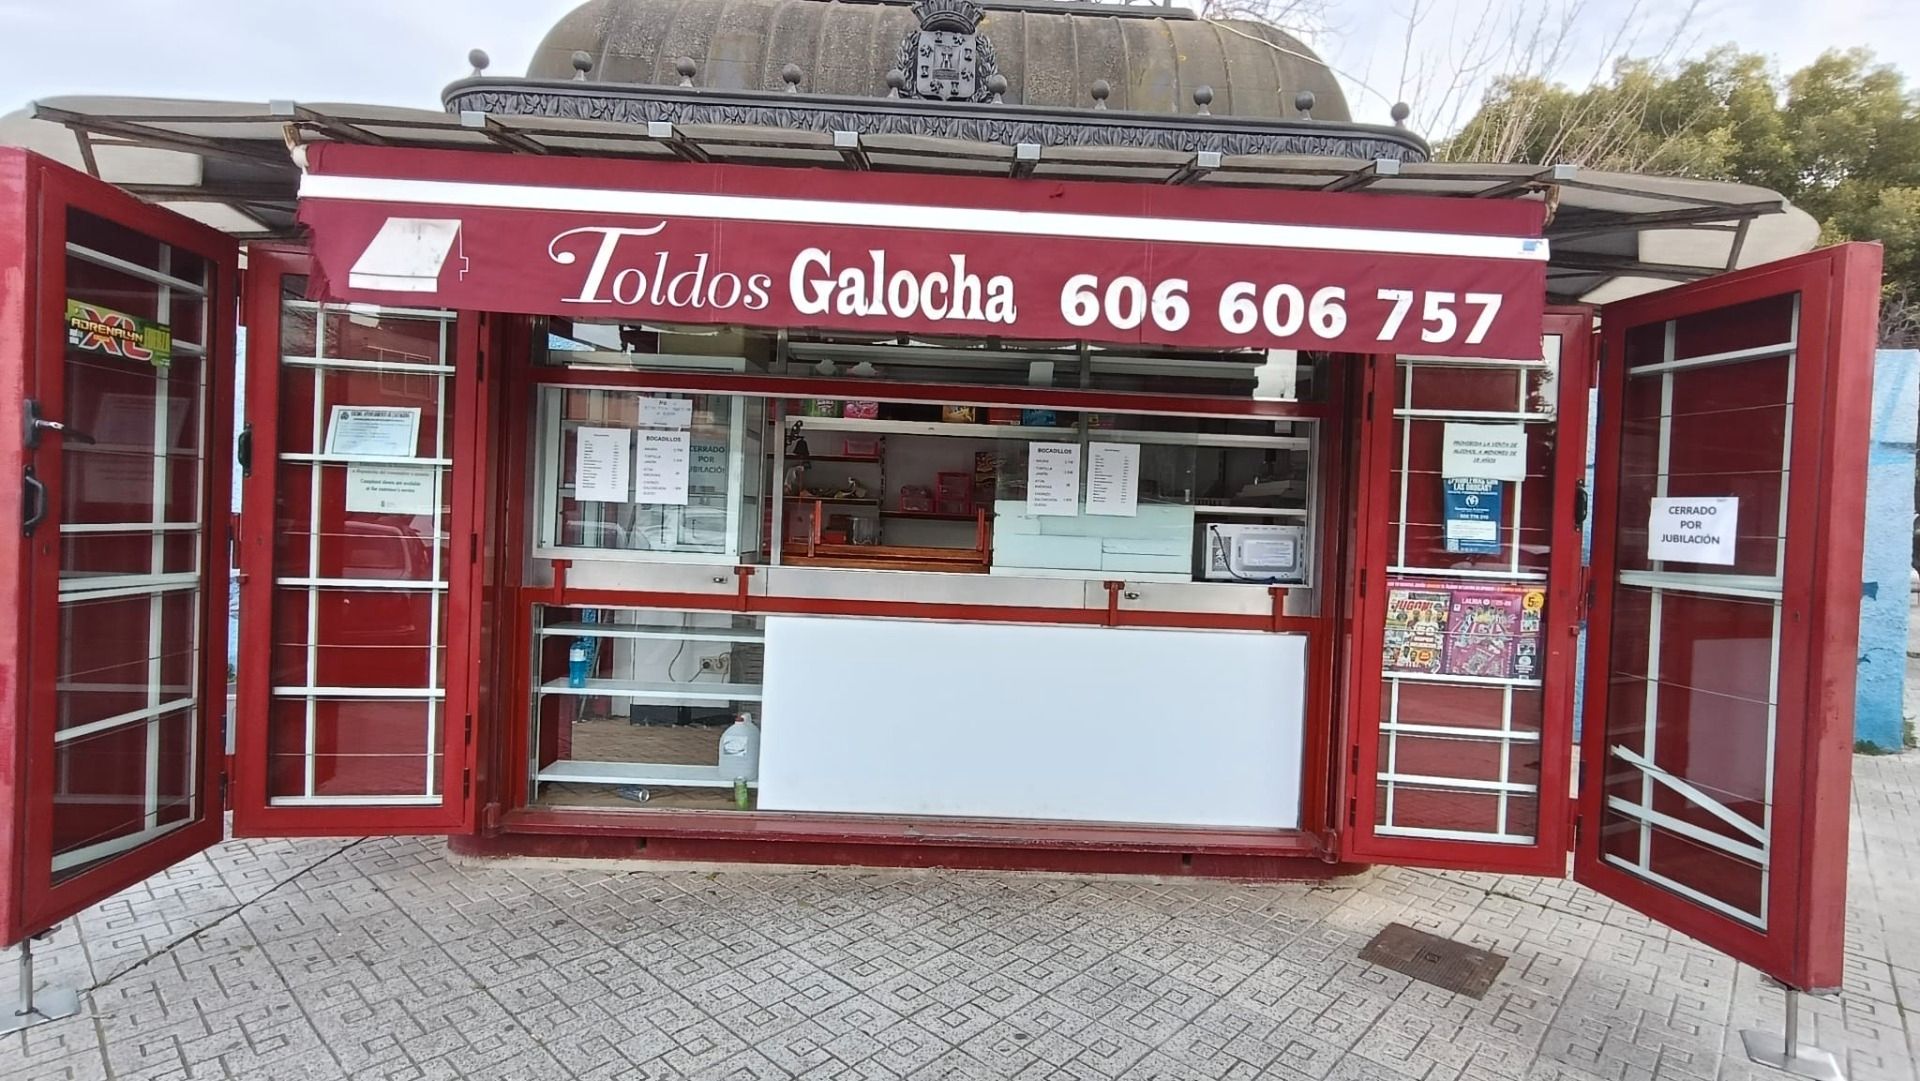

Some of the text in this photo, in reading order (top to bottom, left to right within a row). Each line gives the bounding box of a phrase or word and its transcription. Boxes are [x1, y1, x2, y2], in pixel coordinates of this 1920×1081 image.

[548, 221, 1504, 345] Toldos Galocha 606 606 757
[71, 317, 144, 343] ADRENALYN
[78, 306, 153, 361] XL
[646, 435, 682, 443] BOCADILLOS
[1038, 447, 1072, 455] BOCADILLOS
[1668, 506, 1717, 515] CERRADO
[1680, 520, 1702, 530] POR
[1661, 533, 1720, 544] JUBILACIÓN
